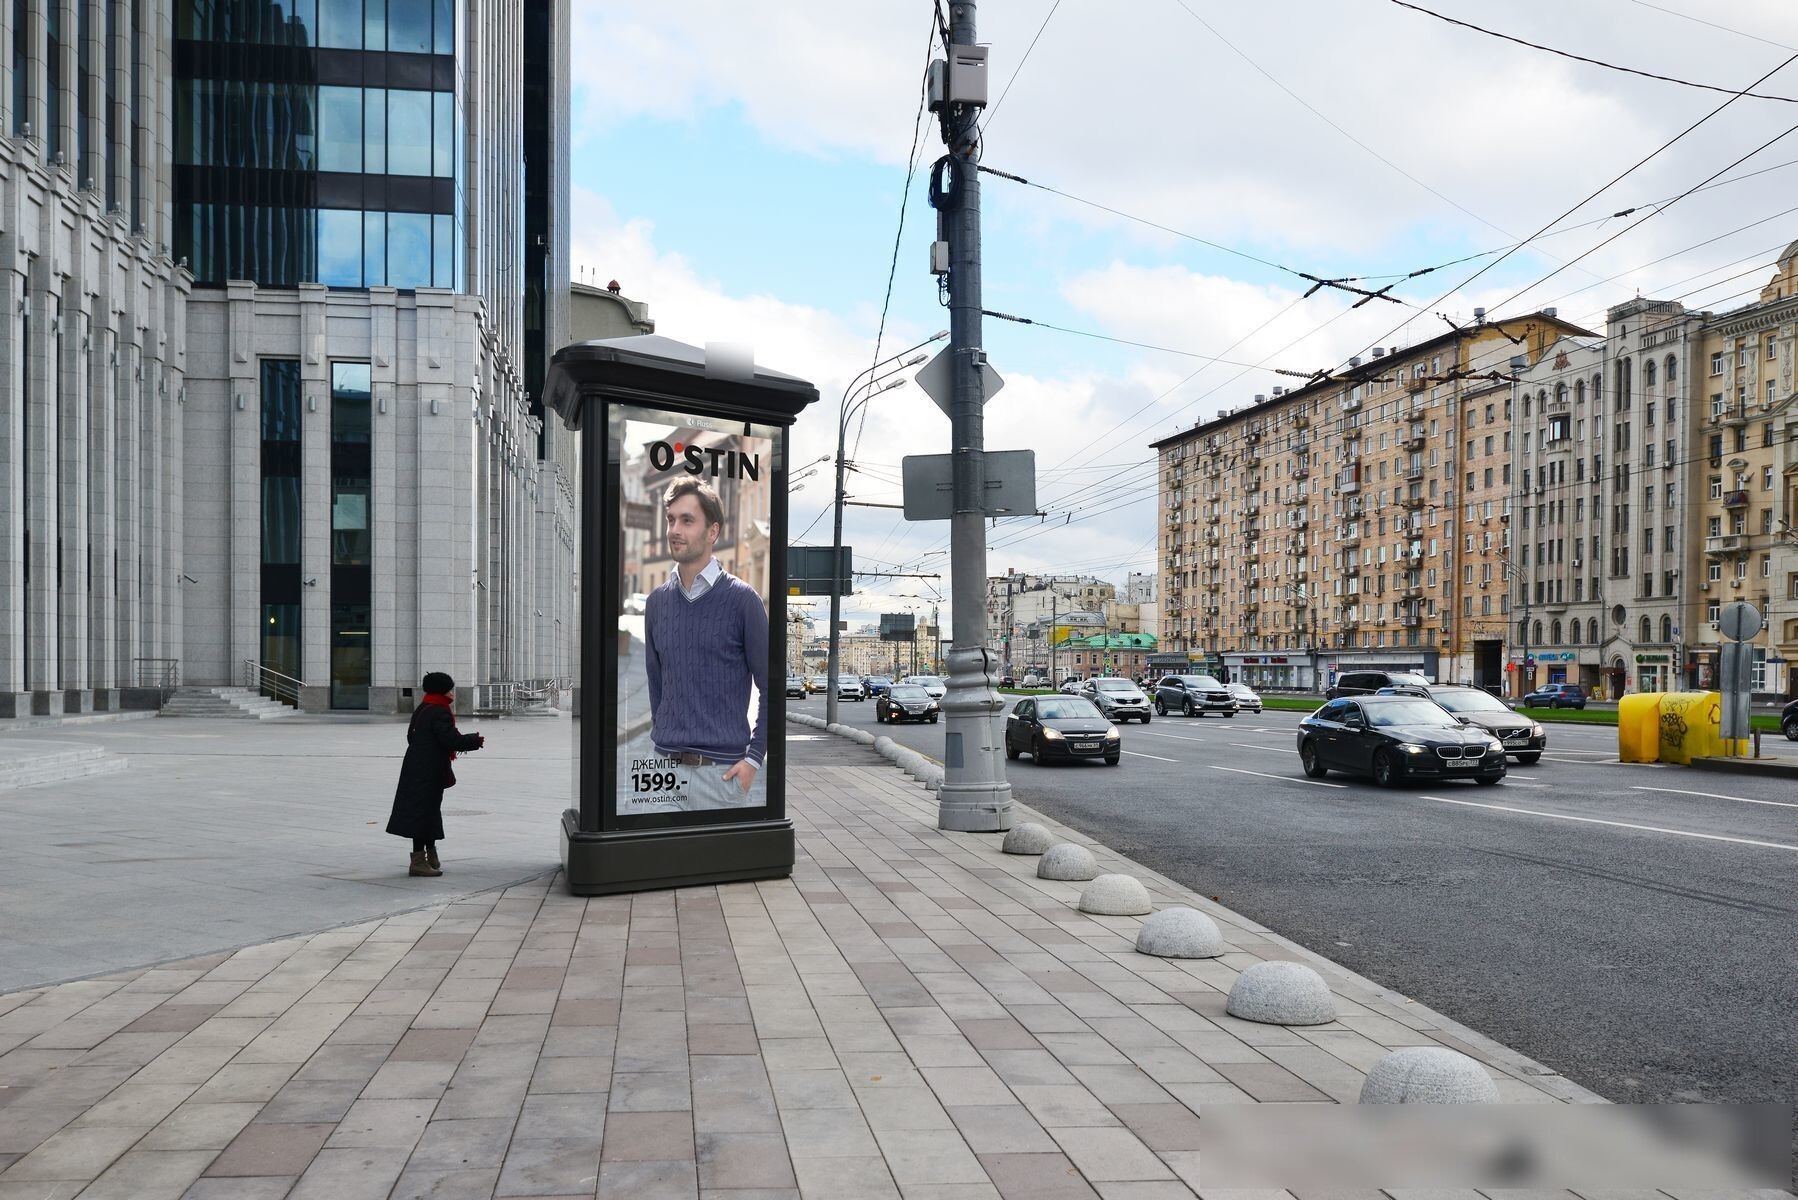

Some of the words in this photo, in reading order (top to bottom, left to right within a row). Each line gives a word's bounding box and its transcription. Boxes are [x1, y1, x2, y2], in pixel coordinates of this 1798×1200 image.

[631, 758, 682, 772] ДЖЕМПЕР
[631, 773, 688, 792] 1599.-
[631, 794, 688, 804] www.ostin.com
